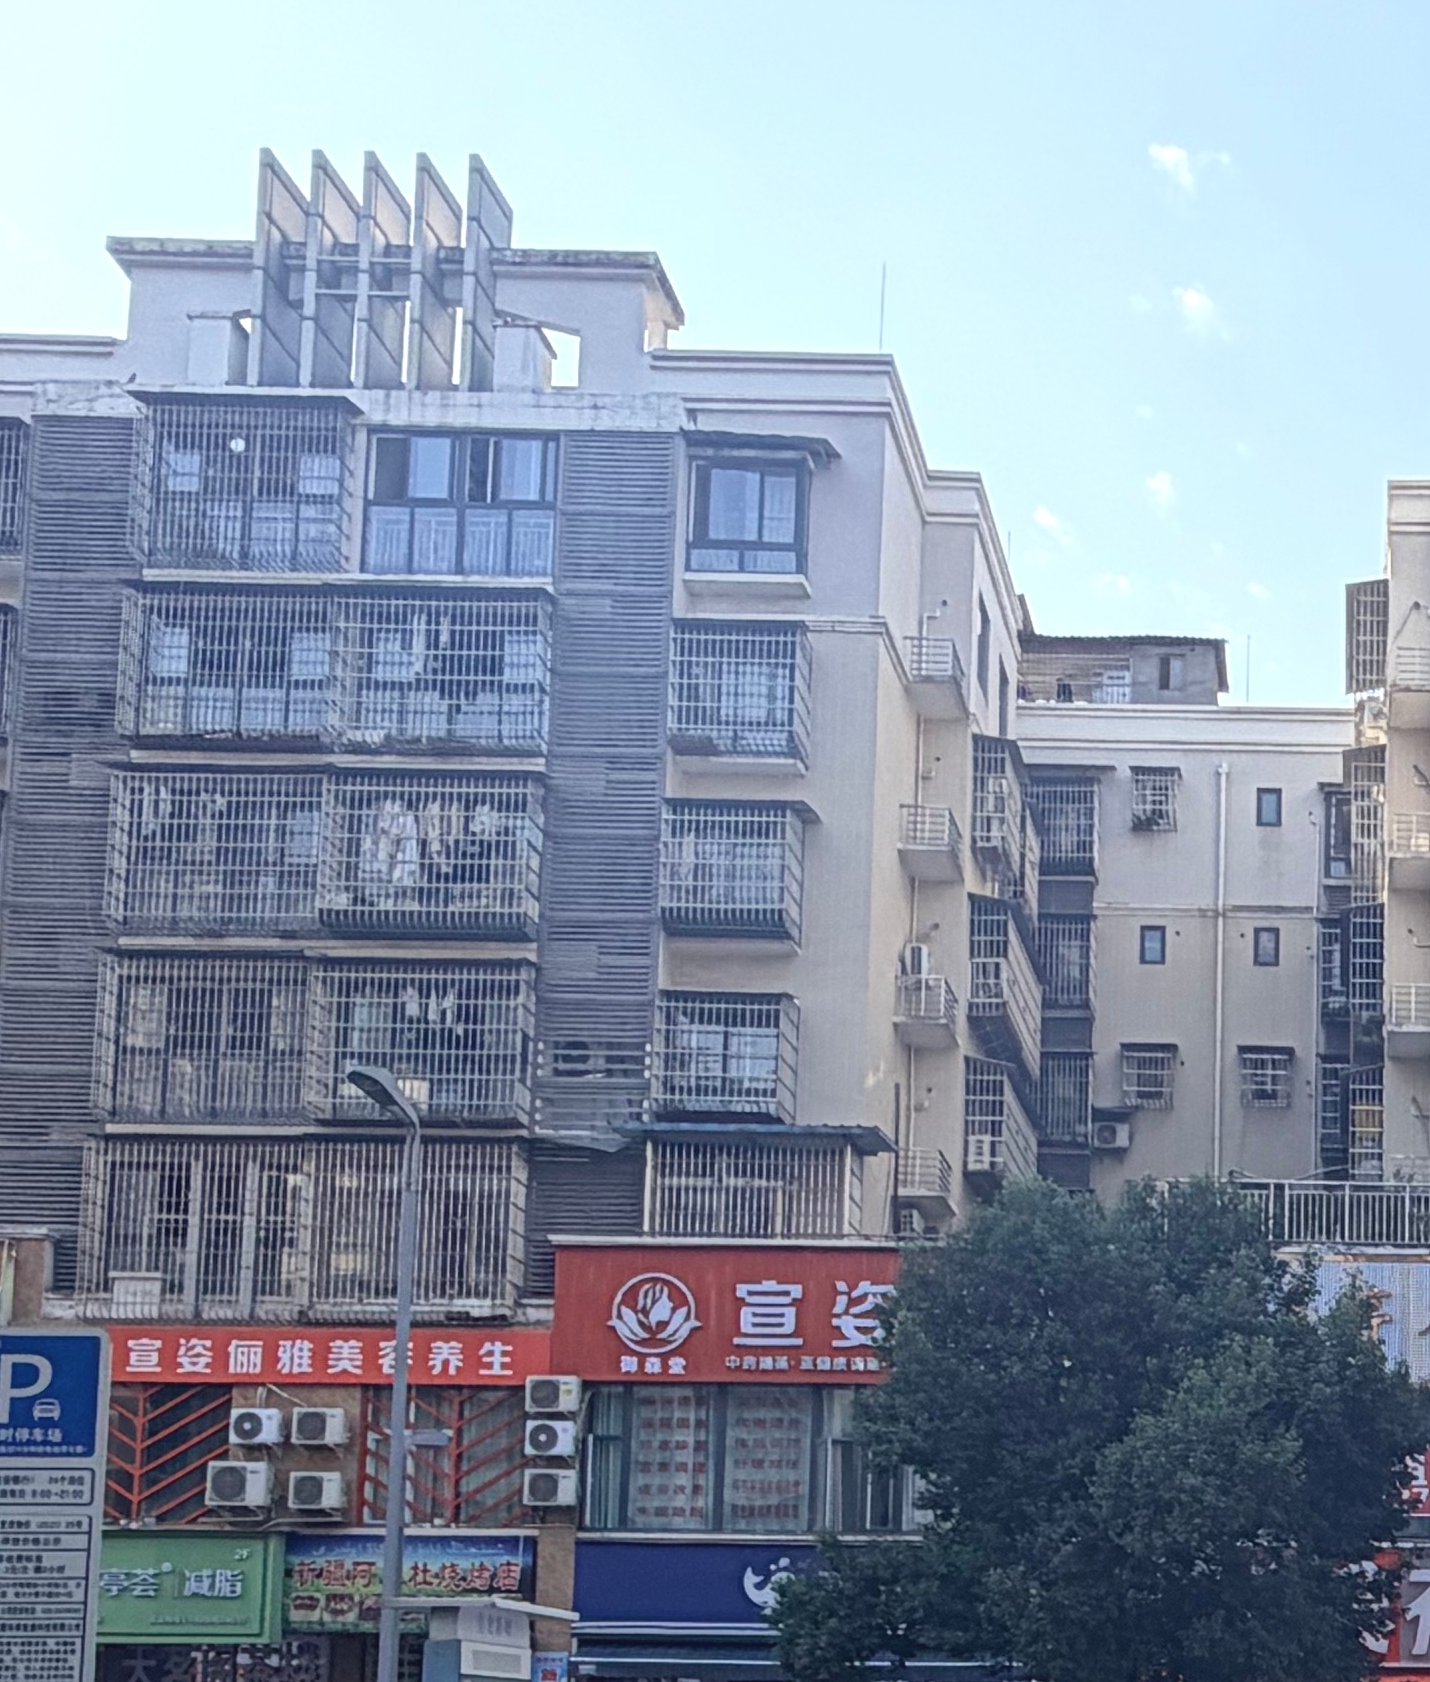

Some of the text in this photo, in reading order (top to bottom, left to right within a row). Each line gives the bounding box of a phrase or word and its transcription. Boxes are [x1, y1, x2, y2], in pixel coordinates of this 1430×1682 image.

[125, 1338, 514, 1376] 宣姿俪雅美容养生
[183, 1568, 244, 1598] 减脂
